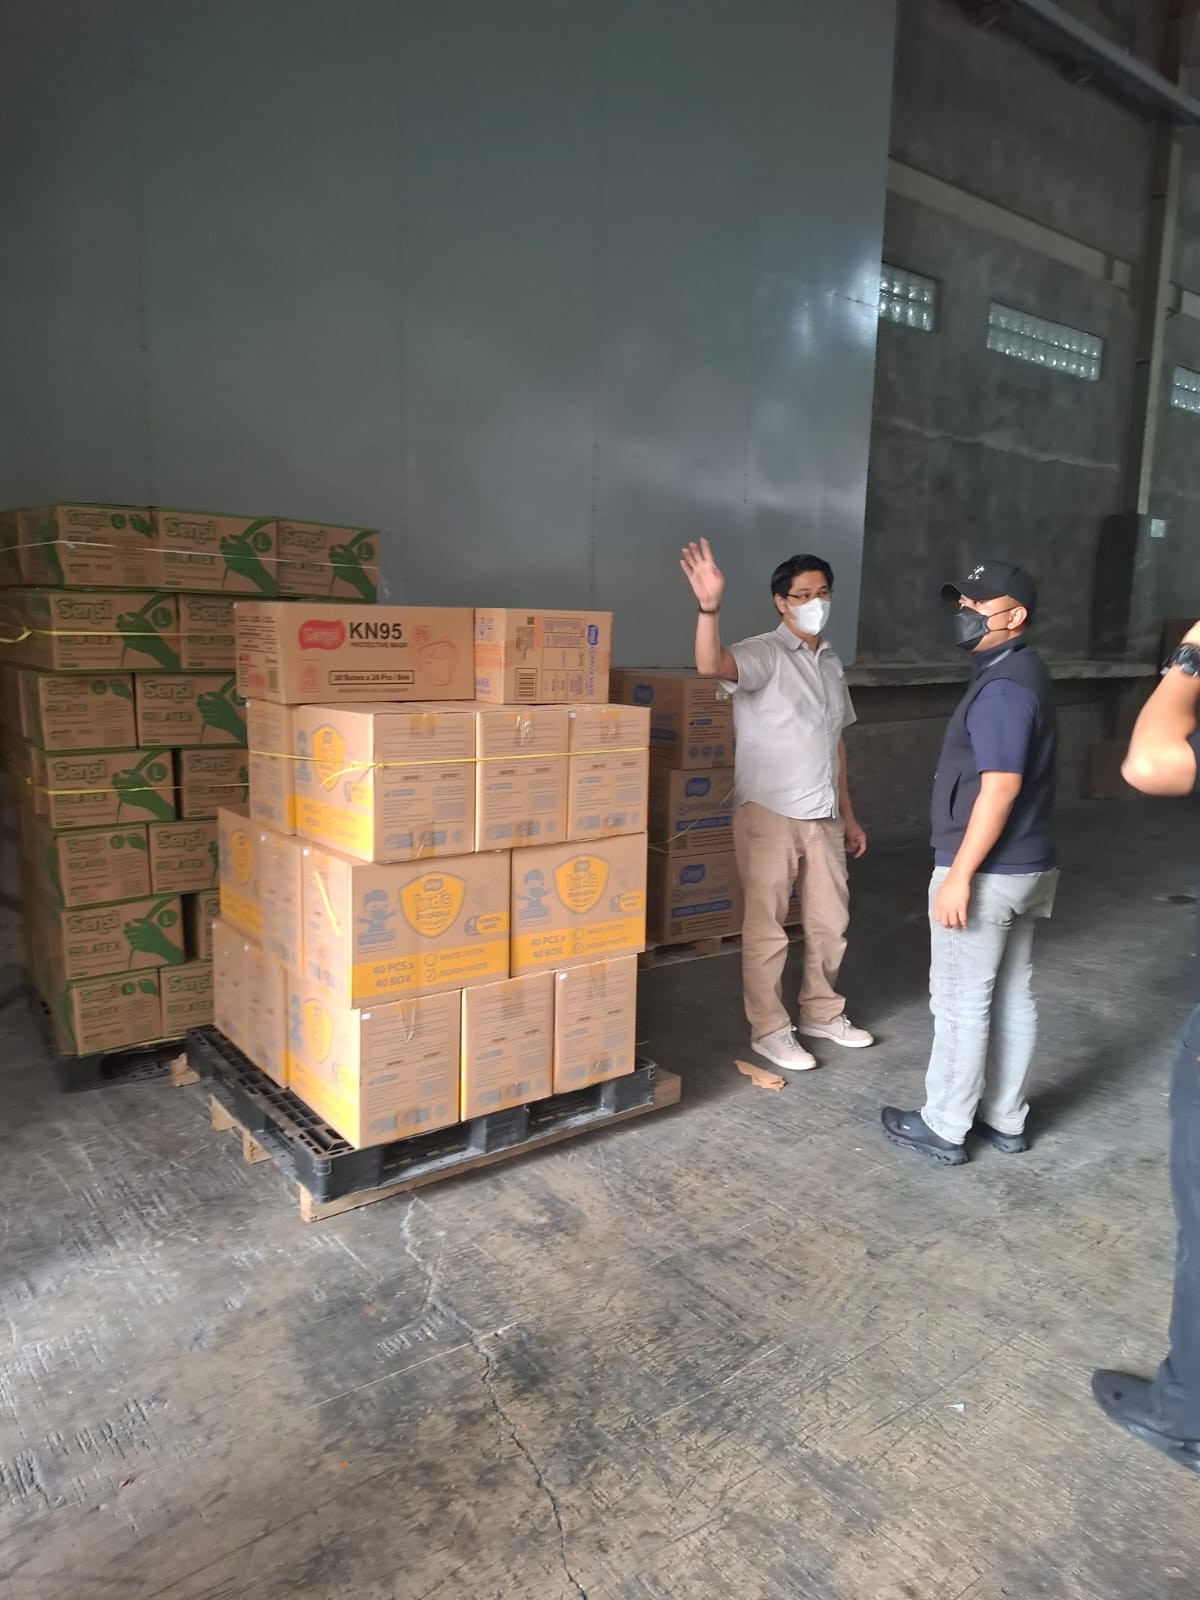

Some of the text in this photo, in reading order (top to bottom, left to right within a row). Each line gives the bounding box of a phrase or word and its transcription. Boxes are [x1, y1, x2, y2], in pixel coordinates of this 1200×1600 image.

[350, 622, 403, 640] KN95
[373, 965, 386, 975] 40
[388, 962, 407, 972] PCS
[376, 974, 412, 987] 40 BOX
